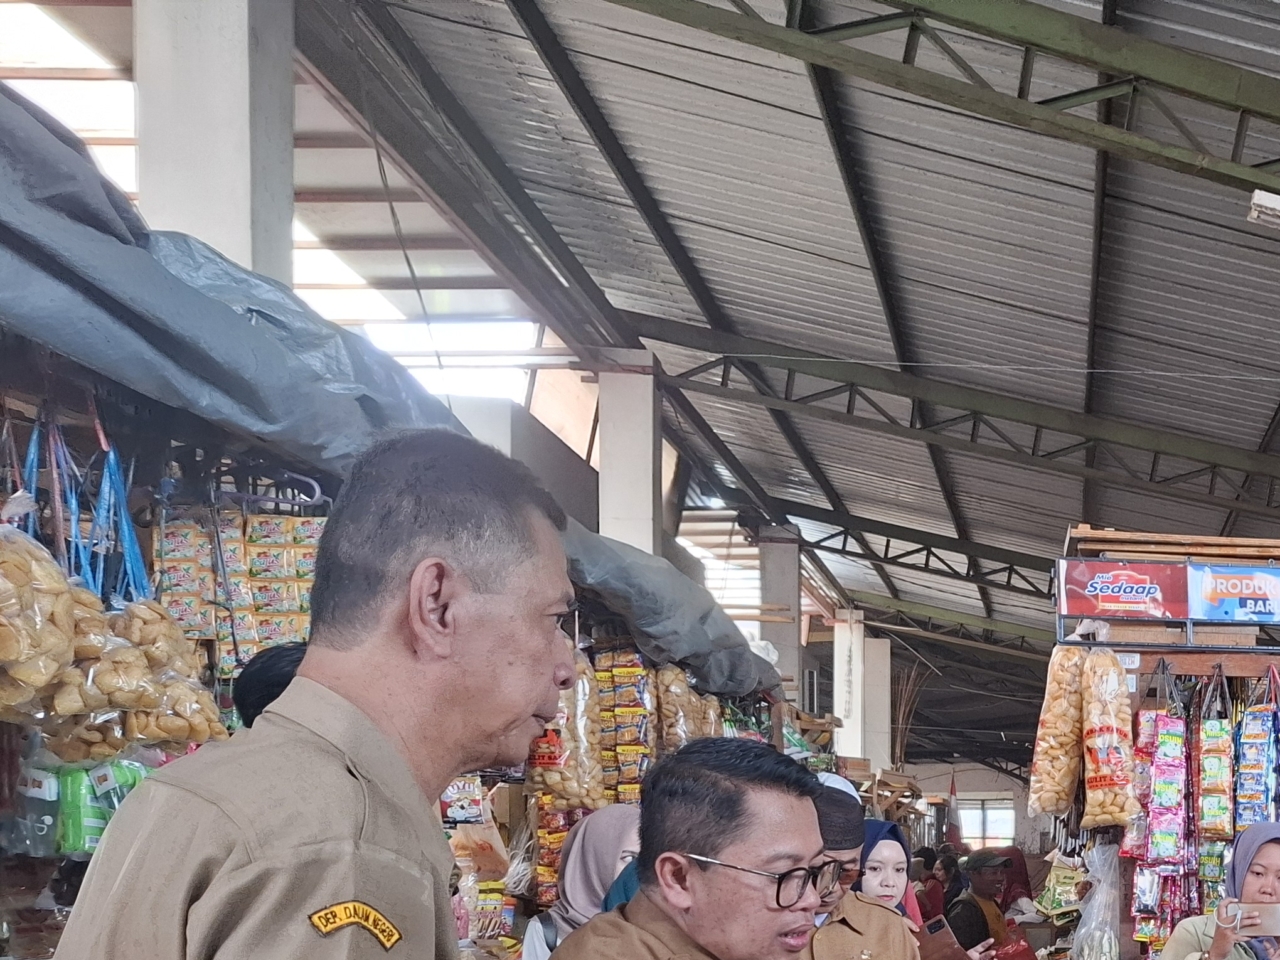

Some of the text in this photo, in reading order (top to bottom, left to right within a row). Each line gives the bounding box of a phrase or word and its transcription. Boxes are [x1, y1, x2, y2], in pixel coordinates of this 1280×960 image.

[1095, 574, 1112, 582] Mie
[1207, 578, 1276, 595] PRODUK
[1086, 581, 1158, 598] Sedaap
